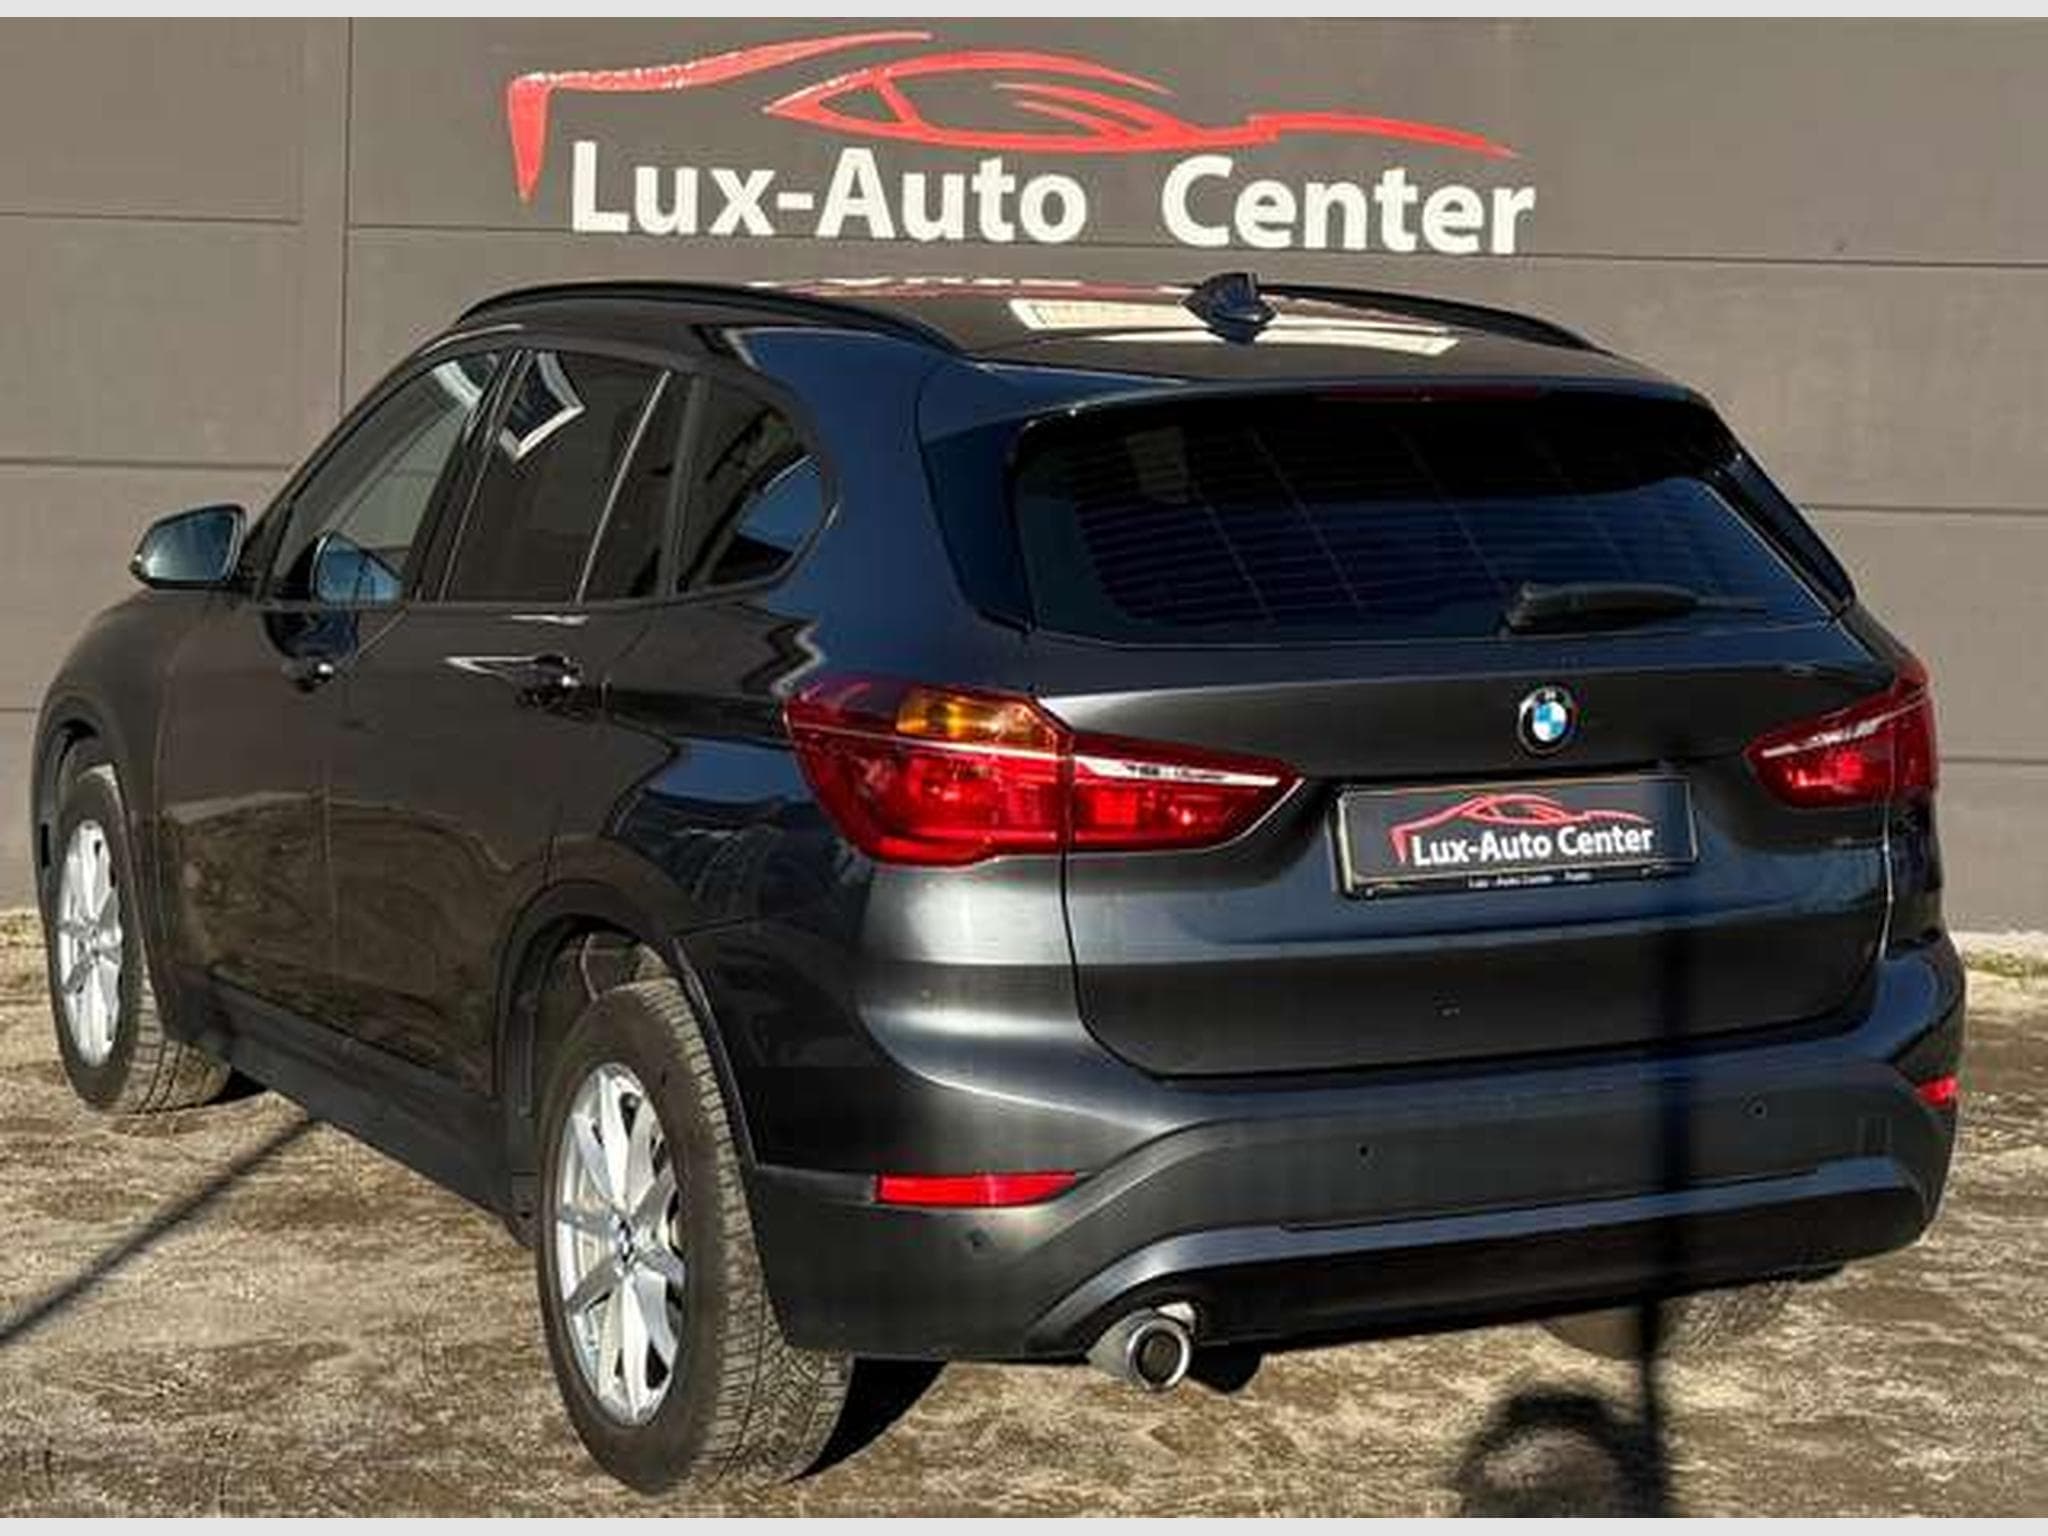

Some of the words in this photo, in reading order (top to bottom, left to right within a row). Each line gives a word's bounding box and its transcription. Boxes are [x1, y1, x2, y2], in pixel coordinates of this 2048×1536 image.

[571, 140, 1087, 243] Lux-Auto
[1161, 155, 1536, 254] Center
[1411, 830, 1553, 867] Lux-Auto
[1556, 825, 1655, 857] Center
